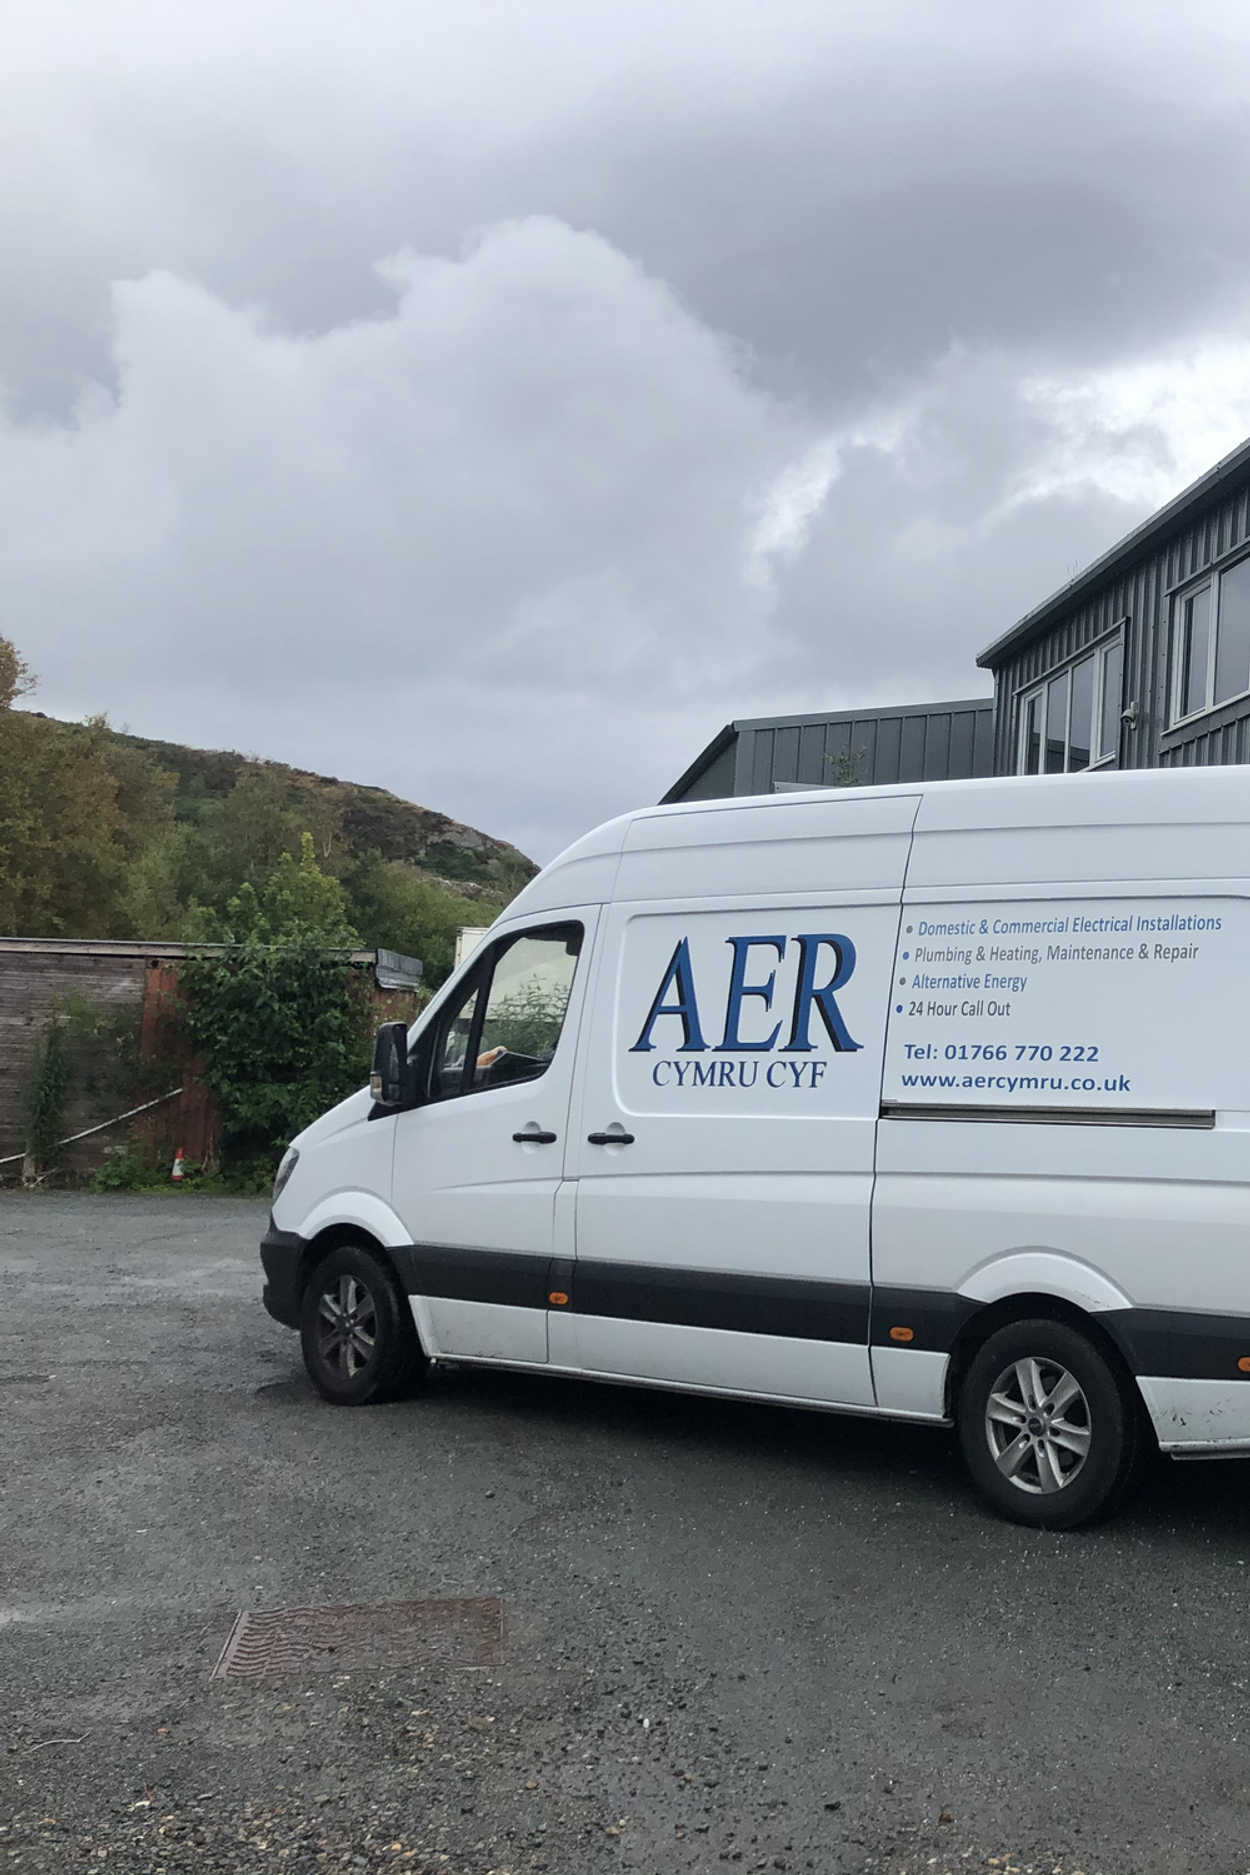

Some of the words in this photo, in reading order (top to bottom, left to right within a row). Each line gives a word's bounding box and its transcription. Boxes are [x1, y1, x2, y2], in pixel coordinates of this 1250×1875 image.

[918, 920, 976, 936] Domestic
[979, 919, 988, 934] &
[993, 917, 1069, 934] Commercial
[1072, 915, 1133, 932] Electrical
[1136, 914, 1222, 931] Installations
[914, 947, 972, 965] Plumbing
[976, 946, 985, 961] &
[990, 945, 1042, 964] Heating,
[1047, 944, 1134, 960] Maintenance
[1138, 943, 1149, 959] &
[1153, 943, 1199, 963] Repair
[628, 933, 864, 1052] AER
[912, 973, 980, 989] Alternative
[984, 973, 1027, 992] Energy
[908, 1001, 923, 1016] 24
[927, 1001, 958, 1016] Hour
[961, 1000, 984, 1016] Call
[987, 1001, 1011, 1016] Out
[904, 1044, 938, 1059] Tel:
[944, 1044, 1008, 1060] 01766
[1014, 1045, 1053, 1061] 770
[1059, 1046, 1099, 1062] 222
[653, 1060, 760, 1089] CYMRU
[766, 1060, 828, 1089] CYF
[901, 1074, 1131, 1092] www.aercymru.co.uk
